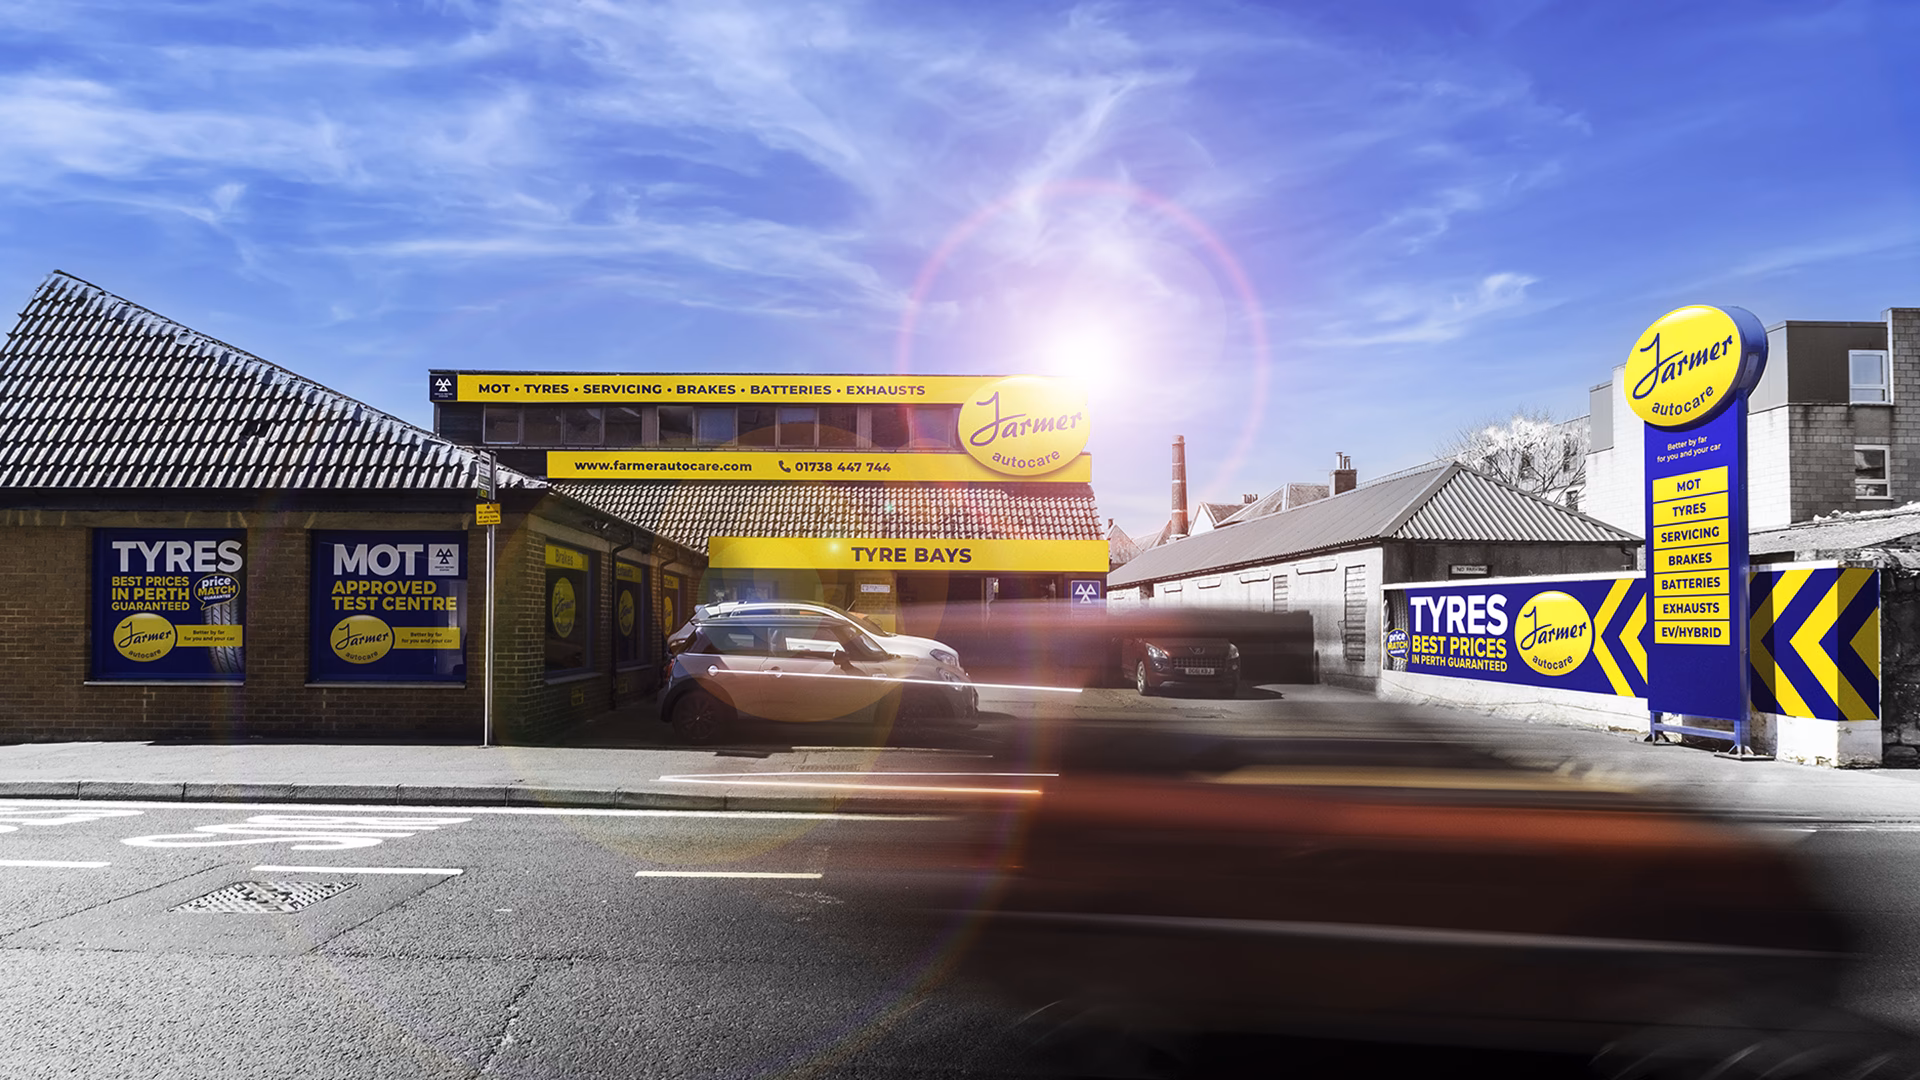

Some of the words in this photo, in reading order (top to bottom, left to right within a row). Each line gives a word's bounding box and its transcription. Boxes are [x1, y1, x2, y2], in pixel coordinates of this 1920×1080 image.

[1632, 332, 1733, 400] Farmer
[478, 384, 511, 394] MOT
[524, 384, 569, 394] TYRES
[583, 384, 662, 394] SERVICING
[676, 385, 736, 395] BRAKES
[750, 385, 832, 395] BATTERIES
[846, 386, 926, 395] EXHAUSTS
[1651, 385, 1714, 416] autocare
[969, 391, 1083, 446] Farmer
[1667, 441, 1687, 451] Better
[1688, 439, 1696, 447] by
[1698, 436, 1708, 444] far
[992, 450, 1060, 469] autocare
[1656, 455, 1666, 463] for
[1666, 453, 1679, 461] you
[1680, 450, 1692, 458] and
[1693, 446, 1709, 456] your
[1710, 443, 1721, 451] car
[575, 460, 752, 471] www.farmerautocare.com
[795, 462, 833, 472] 01738
[837, 462, 862, 472] 447
[866, 462, 891, 472] 744
[1676, 478, 1701, 492] MOT
[1672, 502, 1706, 517] TYRES
[1661, 526, 1720, 543] SERVICING
[112, 540, 243, 573] TYRES
[333, 543, 424, 576] MOT
[555, 548, 573, 566] Brakes
[851, 547, 907, 562] TYRE
[914, 547, 972, 563] BAYS
[1668, 552, 1713, 566] BRAKES
[112, 576, 142, 586] BEST
[146, 576, 190, 586] PRICES
[202, 576, 232, 589] price
[331, 581, 437, 595] APPROVED
[1661, 576, 1721, 590] BATTERIES
[112, 588, 129, 600] IN
[134, 588, 190, 600] PERTH
[198, 585, 236, 597] MATCH
[112, 602, 190, 611] GUARANTEED
[331, 597, 378, 611] TEST
[382, 597, 457, 611] CENTRE
[1662, 602, 1720, 614] EXHAUSTS
[1410, 594, 1508, 636] TYRES
[118, 621, 172, 648] Farmer
[1520, 605, 1587, 650] Farmer
[1661, 626, 1722, 638] EV/HYBRID
[335, 623, 389, 650] Farmer
[1389, 631, 1406, 643] price
[129, 649, 162, 659] autocare
[1412, 635, 1446, 654] BEST
[1450, 637, 1507, 658] PRICES
[345, 651, 378, 661] autocare
[1412, 654, 1420, 664] IN
[1421, 655, 1446, 667] PERTH
[1447, 657, 1508, 672] GUARANTEED
[1533, 655, 1574, 670] autocare
